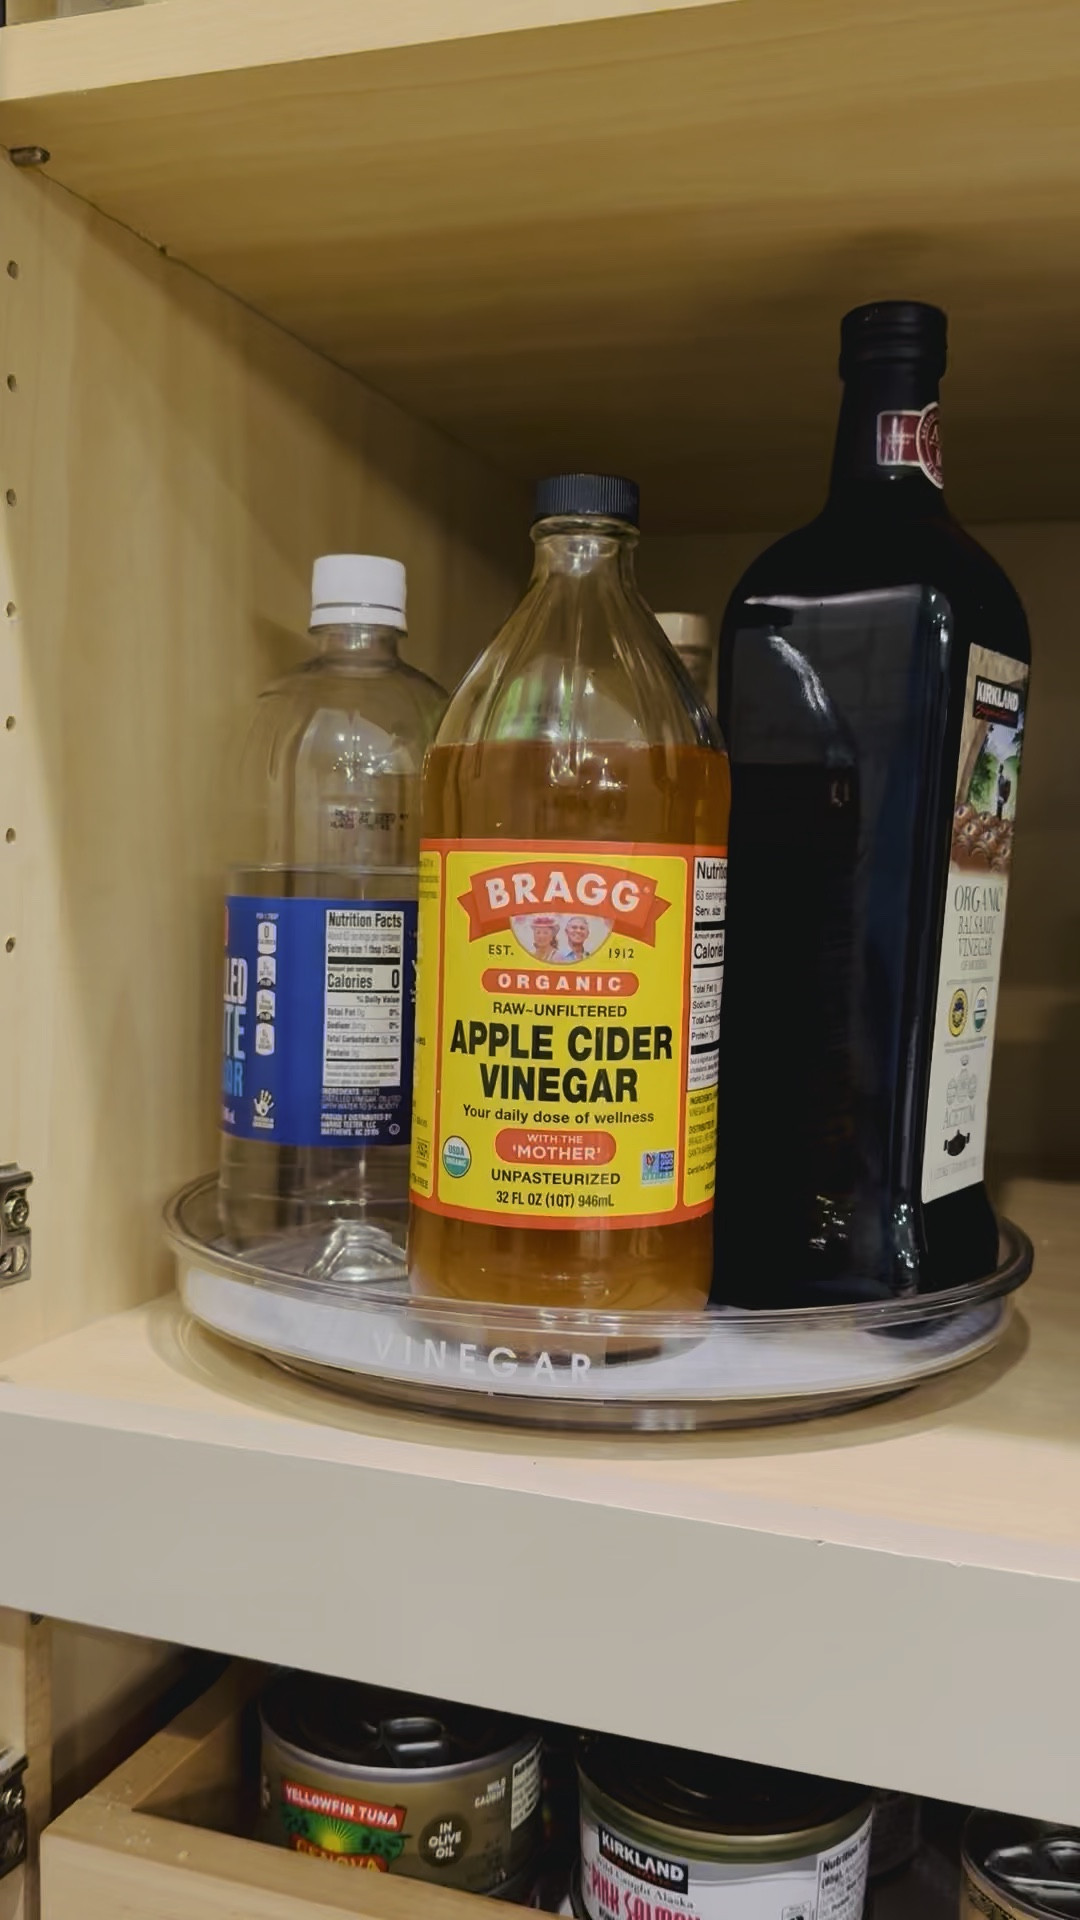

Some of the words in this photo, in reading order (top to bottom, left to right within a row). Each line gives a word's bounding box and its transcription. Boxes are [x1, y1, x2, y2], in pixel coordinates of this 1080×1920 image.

[976, 681, 1019, 712] KIRKLAND
[486, 871, 640, 912] BRAGG
[329, 912, 372, 927] Nutrition
[375, 913, 402, 928] Facts
[488, 944, 514, 955] EST.
[608, 947, 635, 959] 1912
[958, 937, 992, 956] VINEGAR
[328, 973, 373, 989] Calories
[391, 969, 400, 989] 0
[498, 973, 622, 991] ORGANIC
[450, 1019, 553, 1060] APPLE
[567, 1025, 673, 1062] CIDER
[479, 1063, 638, 1103] VINEGAR
[463, 1104, 491, 1119] Your
[495, 1108, 528, 1124] daily
[533, 1111, 569, 1123] dose
[575, 1112, 591, 1124] of
[594, 1112, 655, 1123] wellness
[527, 1134, 558, 1144] WITH
[562, 1136, 583, 1144] THE
[448, 1144, 464, 1156] USDA
[491, 1168, 620, 1185] UNPASTEURIZED
[496, 1191, 509, 1204] 32
[512, 1192, 525, 1205] FL
[528, 1193, 543, 1206] OZ
[546, 1193, 575, 1209] (1QT)
[578, 1194, 614, 1207] 946mL
[373, 1333, 591, 1383] VINEGAR
[285, 1784, 355, 1817] YELLOWFIN
[359, 1805, 398, 1828] TUNA
[440, 1821, 453, 1834] IN
[428, 1831, 462, 1849] OLIVE
[435, 1845, 455, 1859] OIL
[601, 1830, 684, 1882] KIRKLAND
[624, 1889, 702, 1920] SAL
